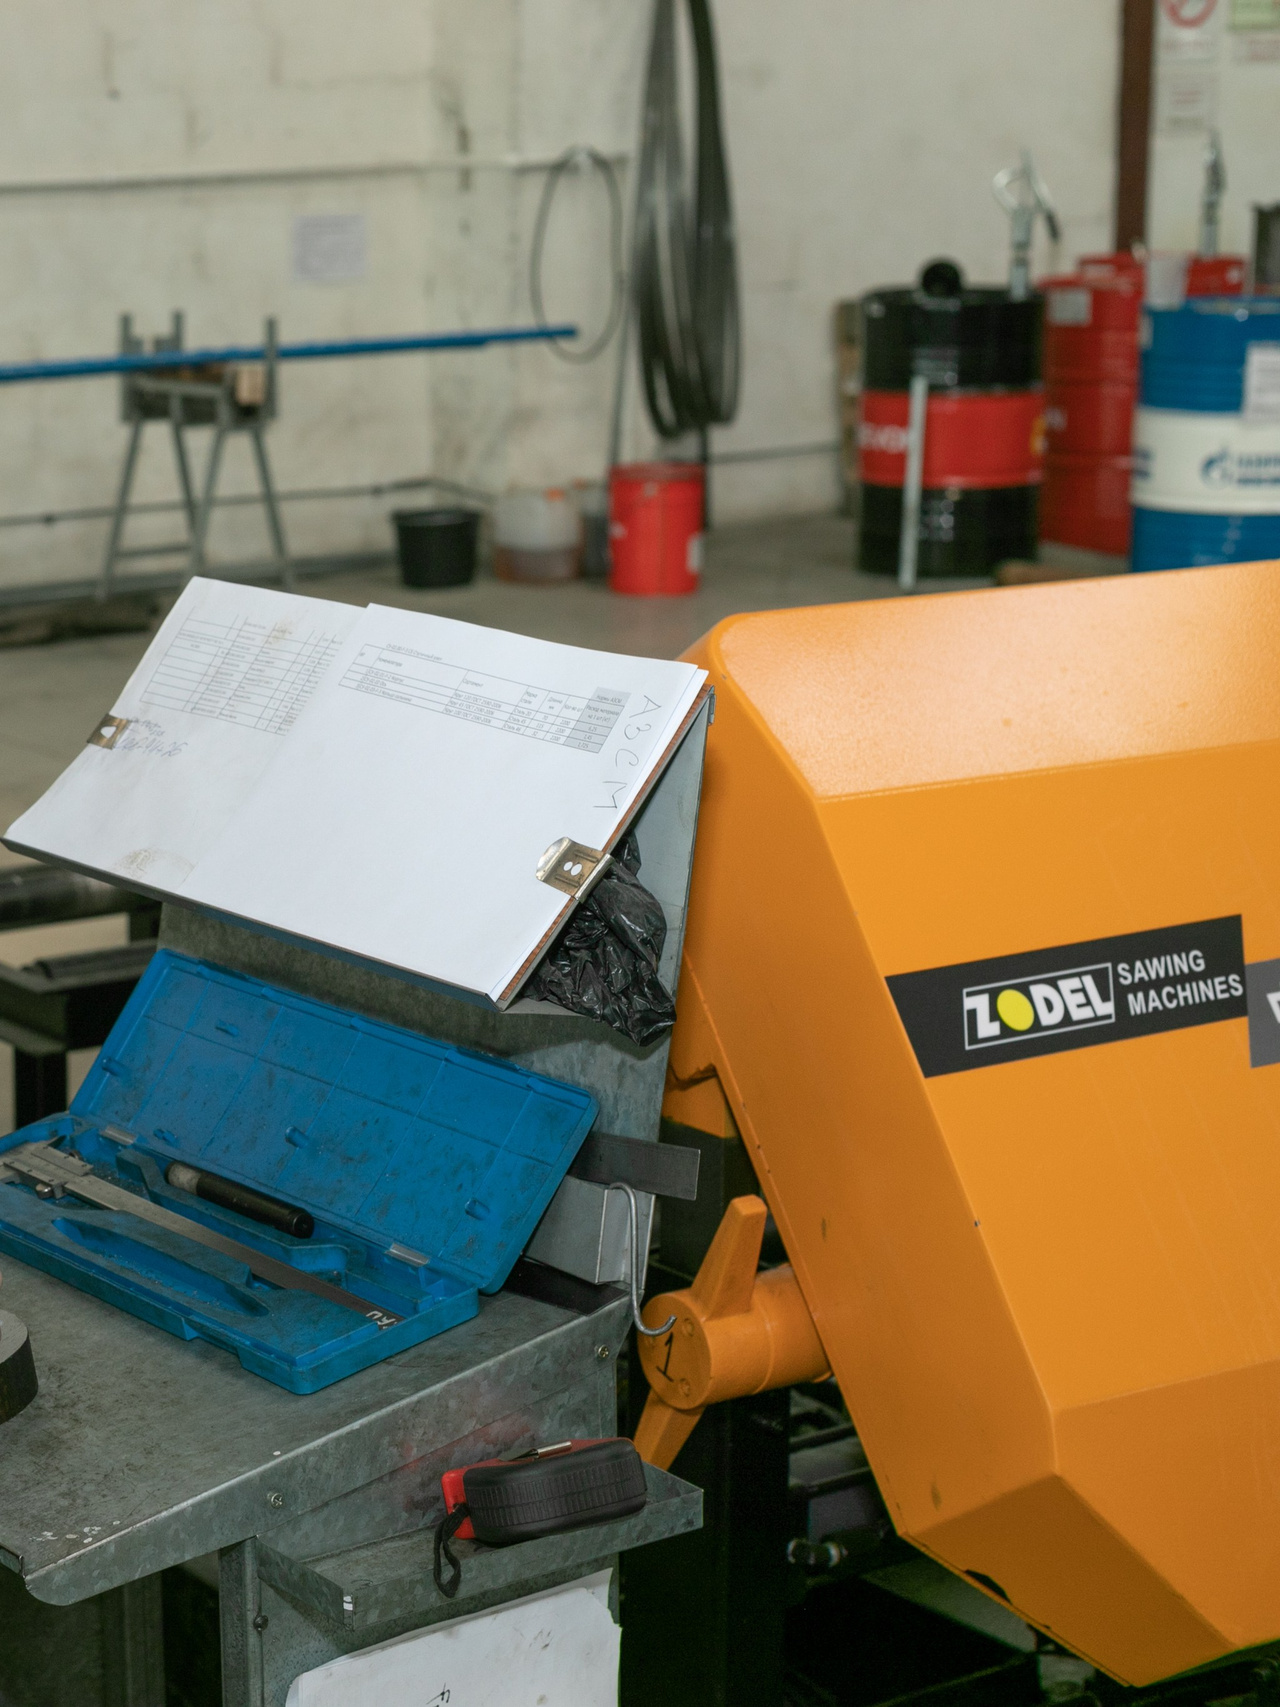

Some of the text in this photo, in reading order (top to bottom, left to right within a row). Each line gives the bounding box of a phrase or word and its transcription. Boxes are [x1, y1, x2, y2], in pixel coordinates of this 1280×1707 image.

[964, 949, 1206, 1039] ZODEL SAWING
[1127, 974, 1244, 1016] MACHINES
[656, 1331, 675, 1383] 1
